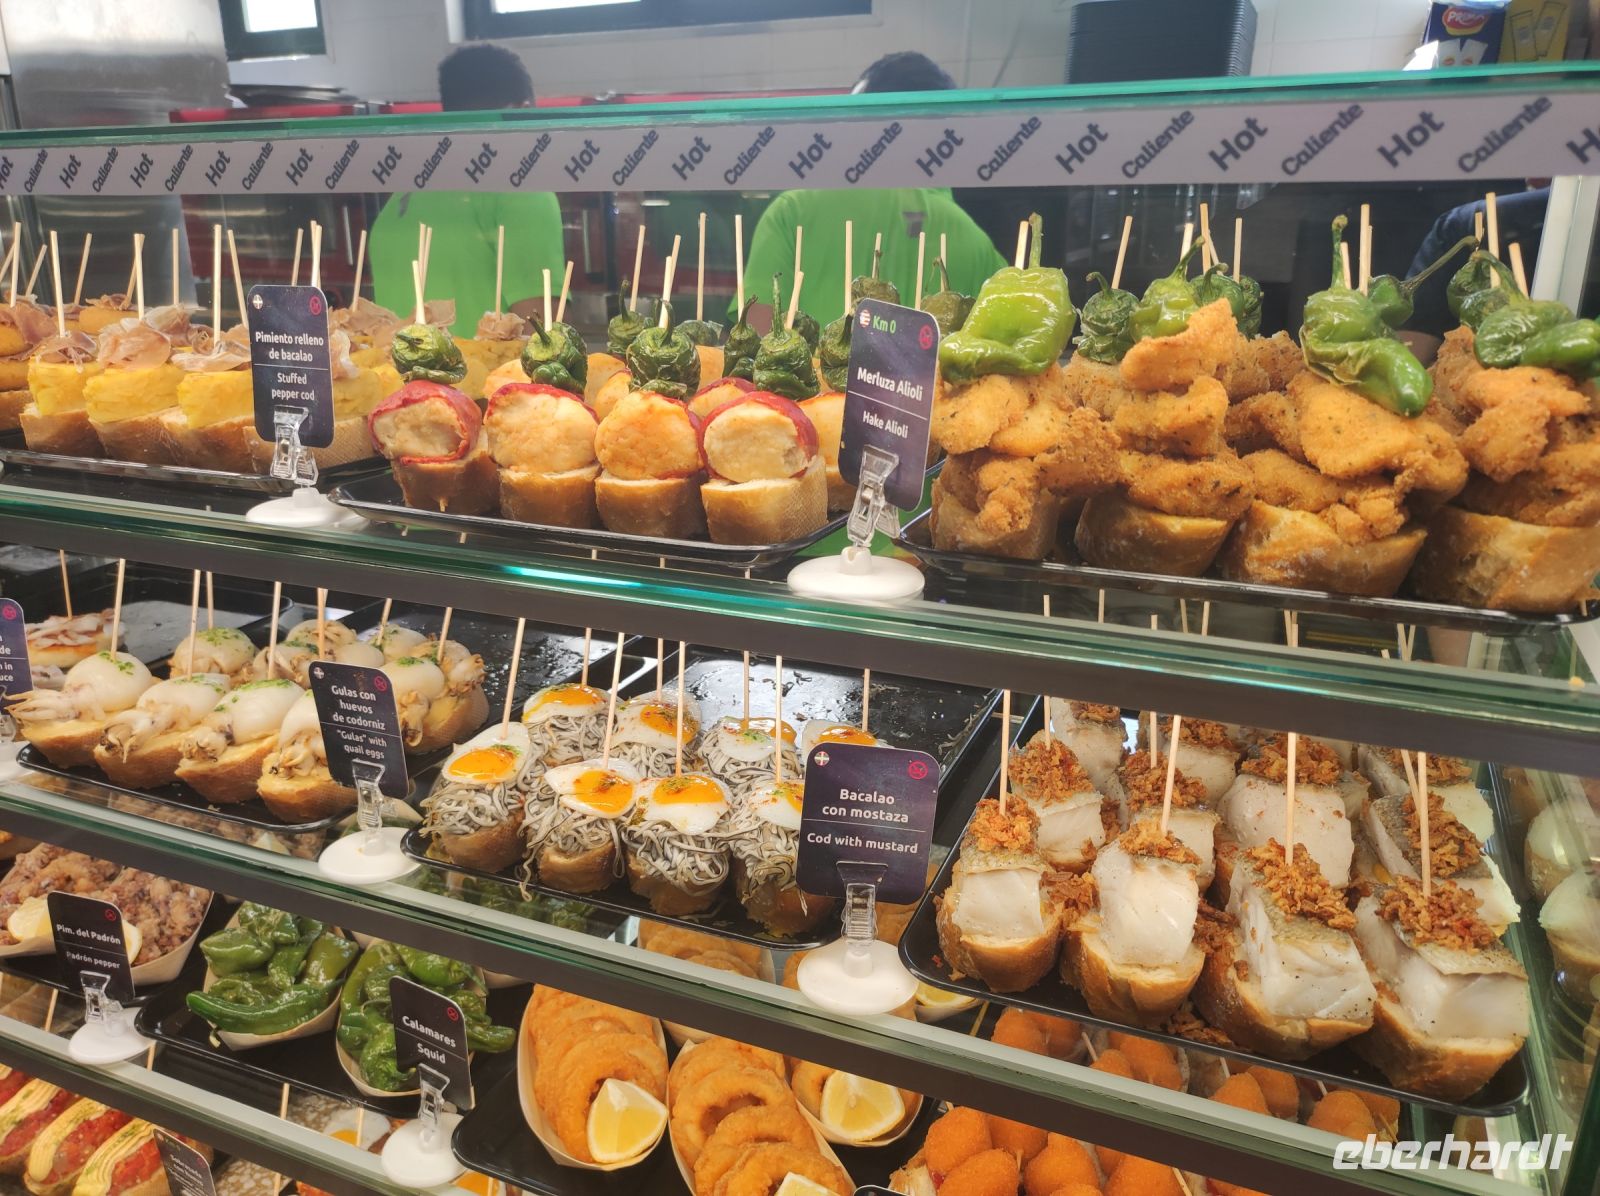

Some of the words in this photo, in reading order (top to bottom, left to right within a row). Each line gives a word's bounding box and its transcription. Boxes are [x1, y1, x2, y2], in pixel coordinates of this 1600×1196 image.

[24, 149, 48, 193] Caliente
[59, 155, 81, 189] Hot
[92, 147, 118, 192] Caliente
[130, 153, 154, 189] Hot
[165, 145, 193, 192] Caliente
[205, 150, 230, 187] Hot
[242, 142, 273, 190] Caliente
[286, 148, 313, 186] Hot
[325, 140, 359, 190] Caliente
[372, 146, 402, 185] Hot
[414, 137, 452, 189] Caliente
[465, 142, 497, 184] Hot
[510, 133, 551, 187] Caliente
[564, 139, 600, 182] Hot
[612, 130, 659, 186] Caliente
[672, 136, 711, 181] Hot
[724, 126, 775, 185] Caliente
[789, 132, 832, 179] Hot
[845, 122, 903, 184] Caliente
[916, 128, 964, 177] Hot
[977, 116, 1041, 181] Caliente
[1055, 123, 1108, 174] Hot
[1121, 110, 1194, 178] Caliente
[1209, 117, 1268, 171] Hot
[1281, 104, 1363, 176] Caliente
[1377, 111, 1444, 168] Hot
[1458, 97, 1552, 173] Caliente
[873, 315, 888, 332] Km
[255, 332, 294, 344] Pimiento
[295, 334, 323, 346] relleno
[269, 348, 279, 359] de
[282, 349, 313, 362] bacalao
[277, 373, 307, 384] Stuffed
[857, 367, 895, 391] Merluza
[897, 380, 923, 401] Alioli
[272, 389, 299, 399] pepper
[301, 390, 314, 400] cod
[863, 411, 884, 429] Hake
[885, 419, 908, 438] Alioli
[331, 685, 357, 697] Gulas
[360, 691, 376, 701] con
[340, 699, 373, 714] huevos
[333, 712, 344, 722] de
[346, 715, 385, 730] codorniz
[337, 730, 366, 742] "Gulas"
[369, 736, 387, 747] with
[344, 745, 364, 754] quail
[366, 749, 384, 759] eggs
[840, 789, 895, 804] Bacalao
[822, 806, 846, 816] con
[851, 810, 908, 823] mostaza
[807, 833, 831, 844] Cod
[835, 836, 862, 846] with
[866, 840, 918, 853] mustard
[57, 924, 75, 934] Pim.
[76, 928, 89, 938] del
[91, 931, 121, 944] Padrón
[94, 958, 120, 969] pepper
[402, 1016, 456, 1047] Calamares
[417, 1043, 446, 1064] Squid
